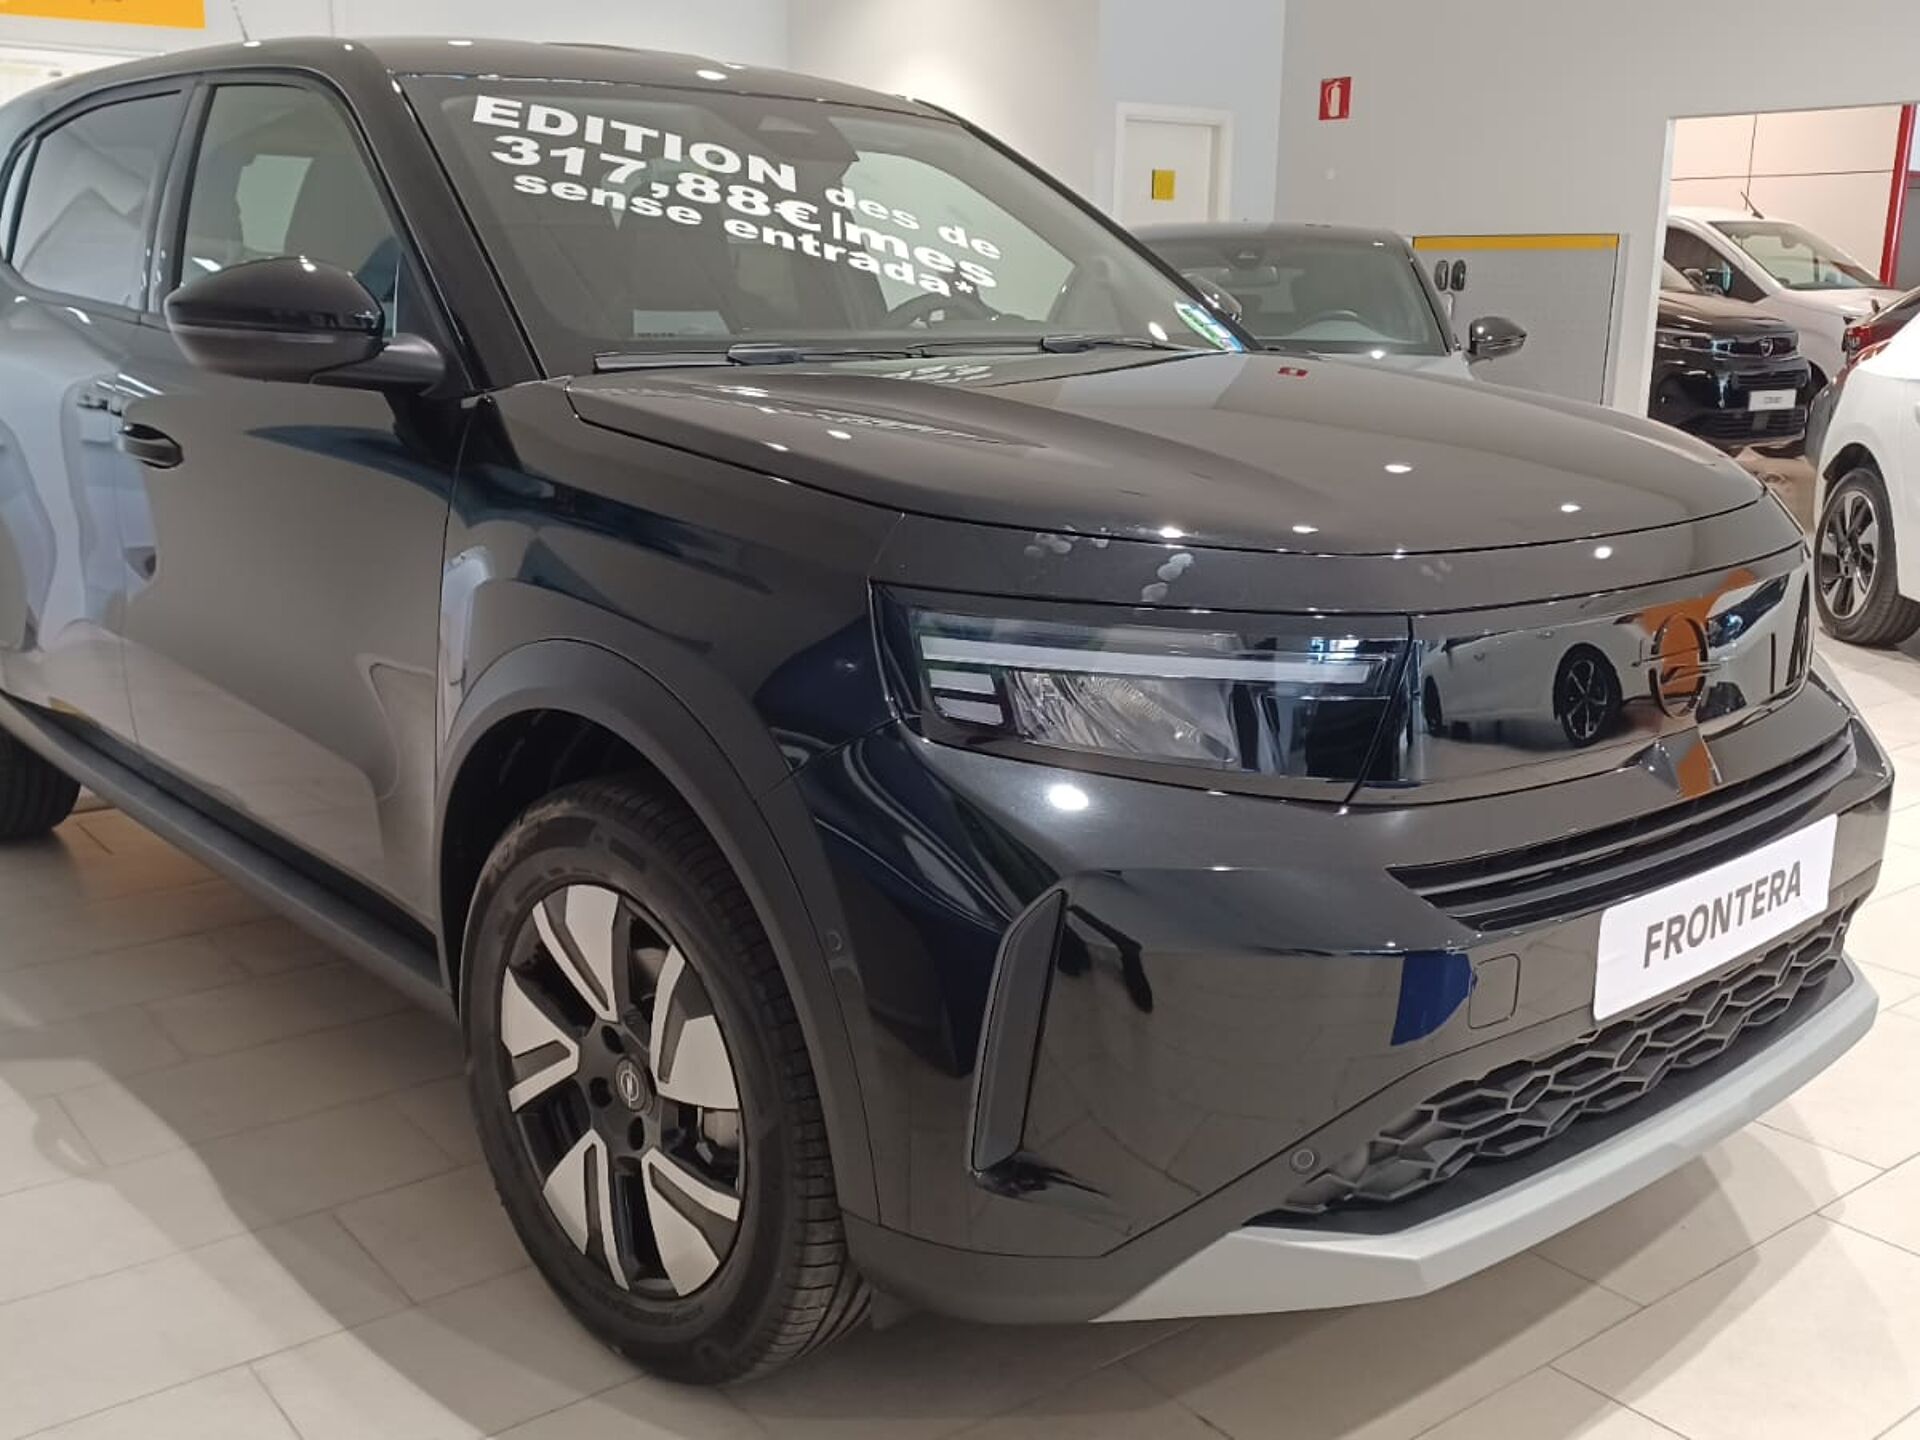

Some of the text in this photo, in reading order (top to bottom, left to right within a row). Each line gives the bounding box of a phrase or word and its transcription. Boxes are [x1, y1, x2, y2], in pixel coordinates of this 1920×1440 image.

[473, 95, 1001, 259] EDITION des de
[513, 175, 702, 224] sense
[1643, 861, 1801, 968] FRONTERA
